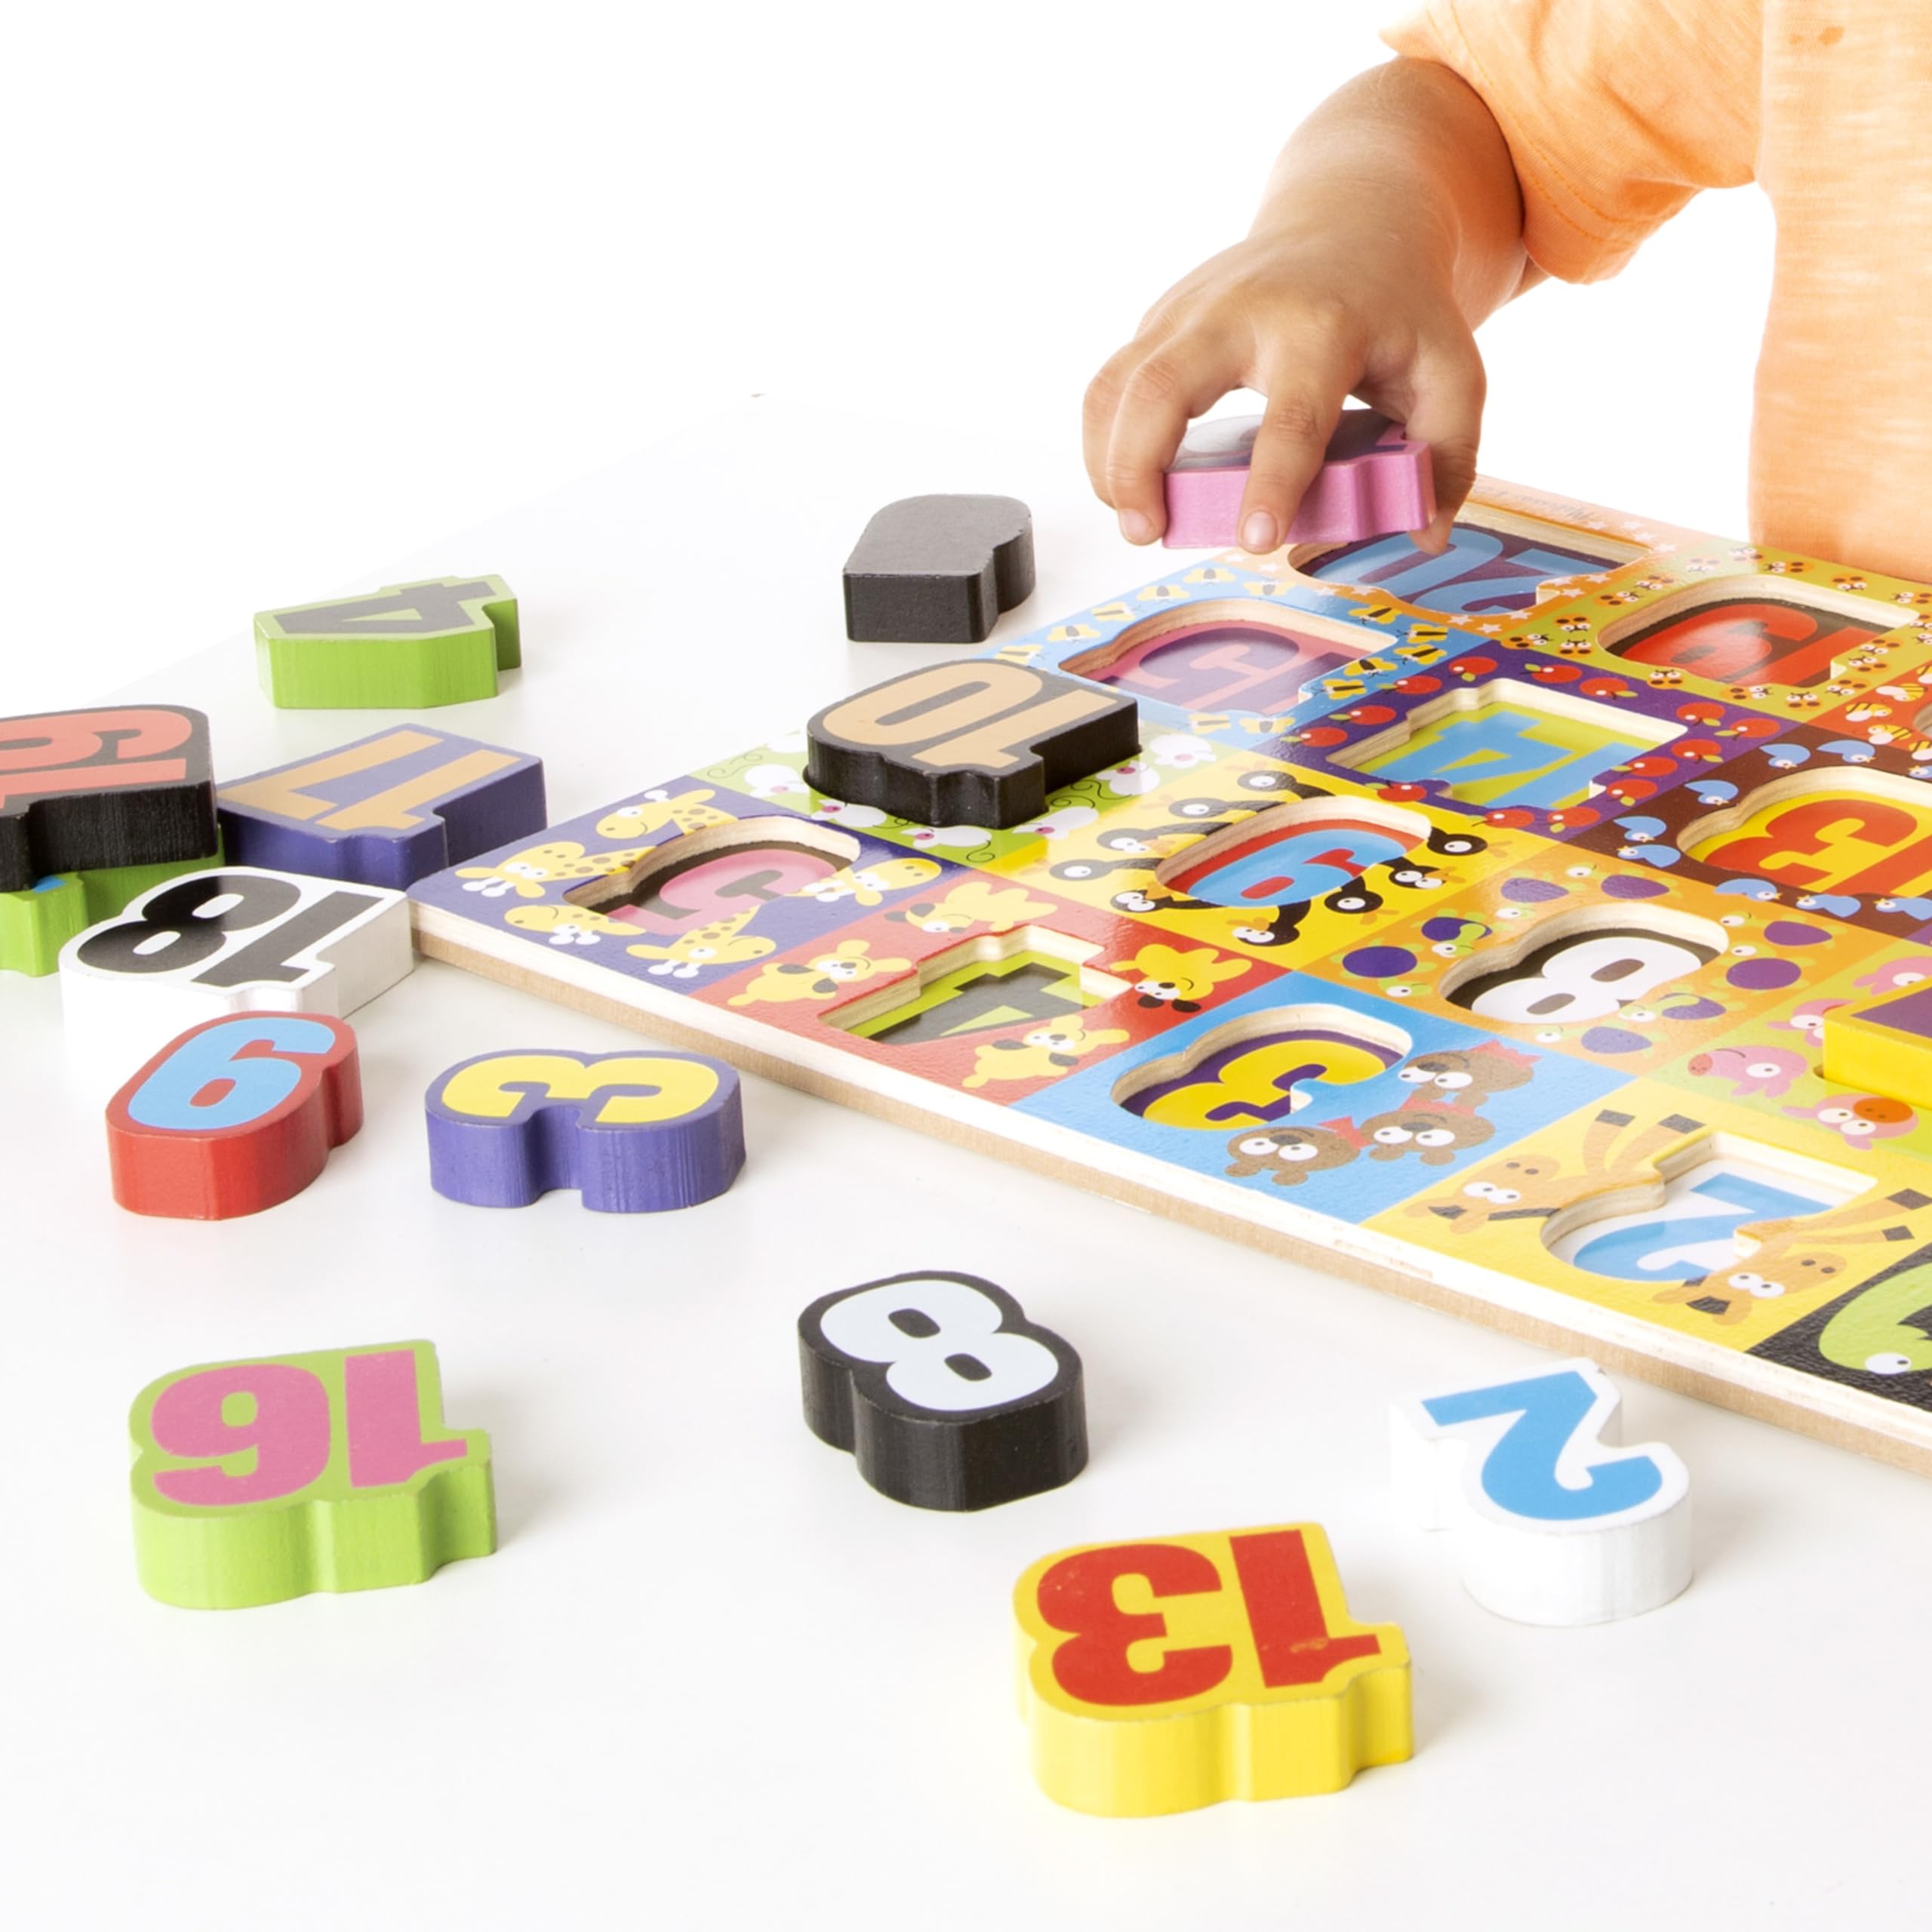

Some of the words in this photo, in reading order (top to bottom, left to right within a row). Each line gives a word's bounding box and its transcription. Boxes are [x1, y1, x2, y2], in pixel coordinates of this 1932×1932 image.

[273, 581, 497, 635] 4
[823, 663, 1117, 768] 10
[217, 730, 522, 832] 17
[78, 874, 385, 987] 18
[1471, 936, 1702, 1024] 8
[442, 1054, 718, 1124] 3
[1143, 1039, 1386, 1130] 3
[1574, 1172, 1835, 1282] 2
[820, 1280, 1060, 1412] 8
[152, 1349, 468, 1506] 16
[1421, 1370, 1663, 1521] 2
[1036, 1529, 1383, 1707] 13
